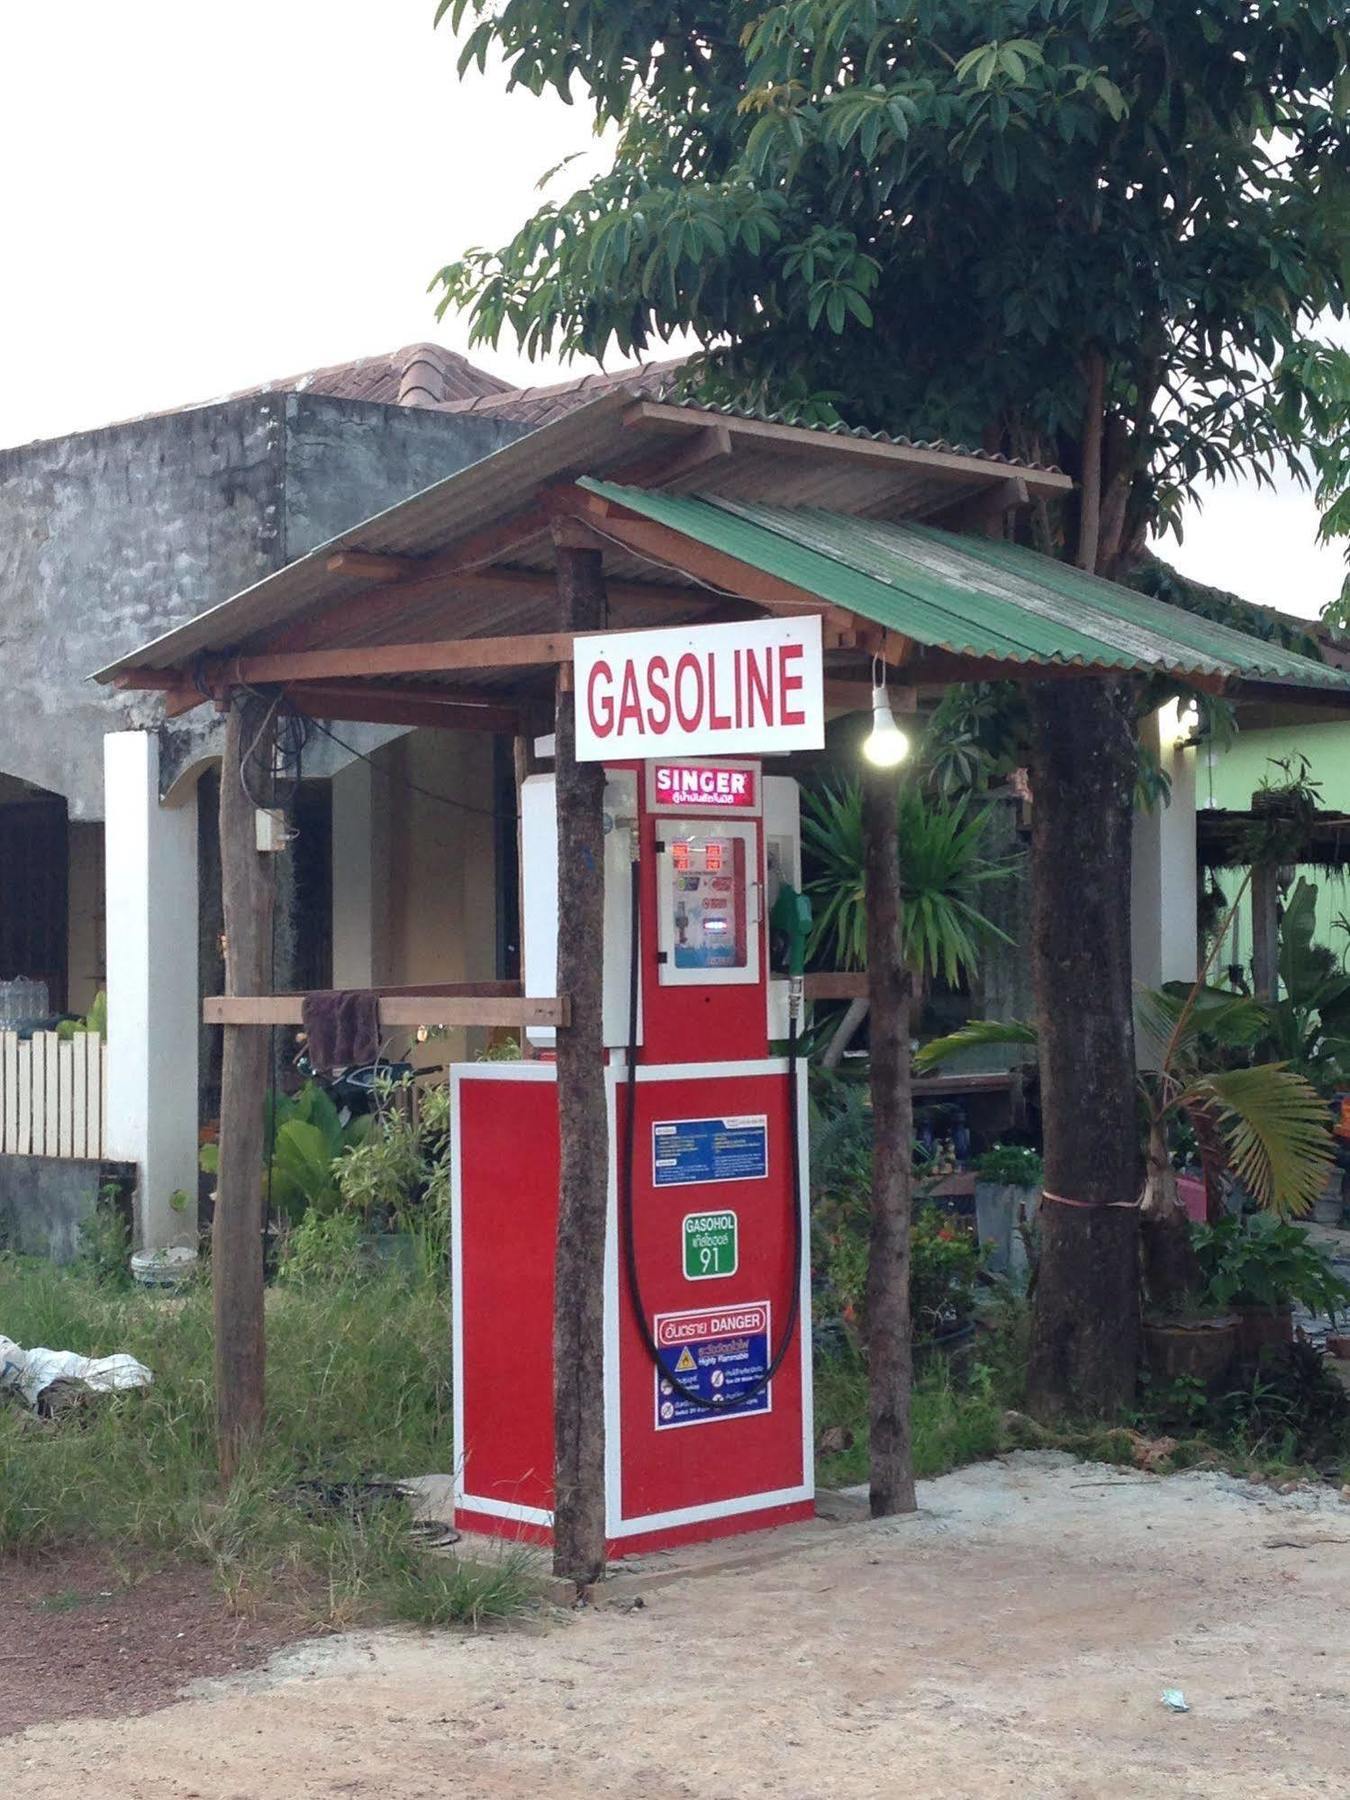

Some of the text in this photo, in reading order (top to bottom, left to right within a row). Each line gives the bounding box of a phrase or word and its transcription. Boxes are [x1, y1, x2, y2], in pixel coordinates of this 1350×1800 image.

[587, 644, 805, 738] GASOLINE
[657, 768, 746, 794] SINGER
[686, 1216, 734, 1233] GASOHOL
[700, 1247, 719, 1273] 91
[665, 1313, 760, 1339] อันตราย DANGER
